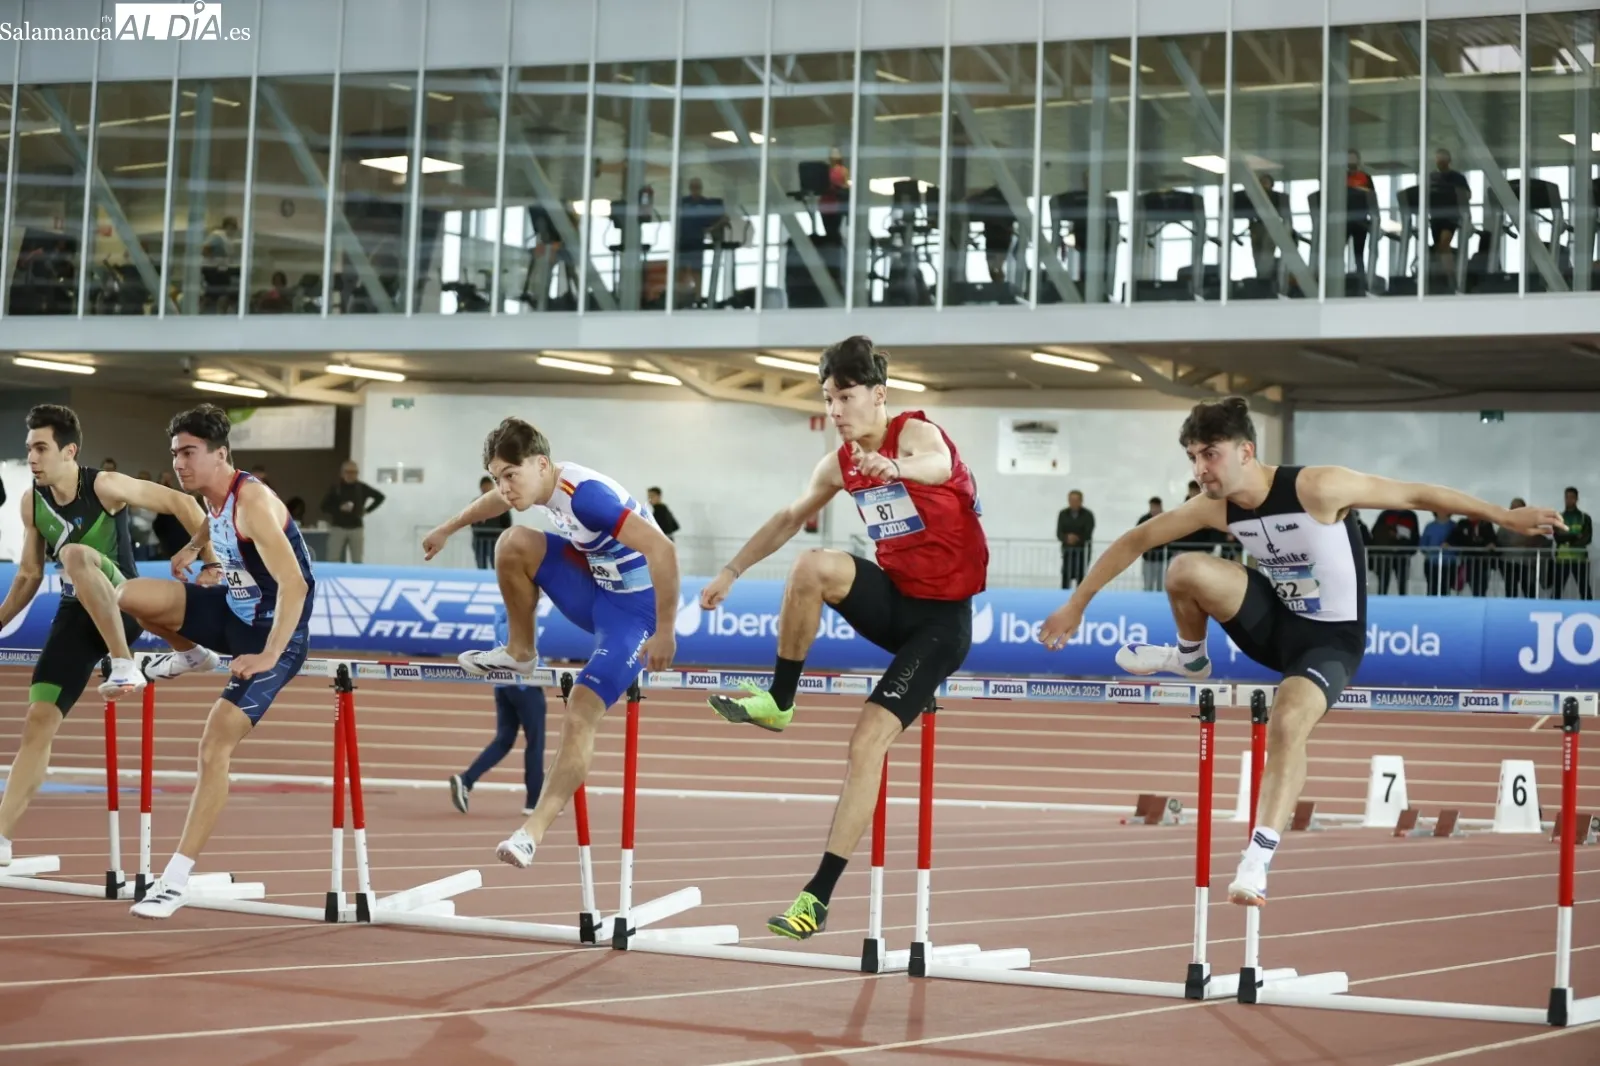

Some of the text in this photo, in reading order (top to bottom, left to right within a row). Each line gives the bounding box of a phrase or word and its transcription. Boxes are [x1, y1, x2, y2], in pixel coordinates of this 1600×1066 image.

[876, 503, 894, 521] 87
[689, 674, 718, 685] Joma
[799, 678, 823, 689] oma
[992, 683, 1024, 695] Joma
[1031, 684, 1101, 697] SALAMANCA 2025
[1108, 687, 1142, 699] Joma
[1338, 693, 1368, 704] oma
[1376, 693, 1454, 706] SALAMANCA 2025
[1462, 696, 1499, 707] Joma
[1382, 772, 1397, 803] 7
[1512, 774, 1527, 807] 6
